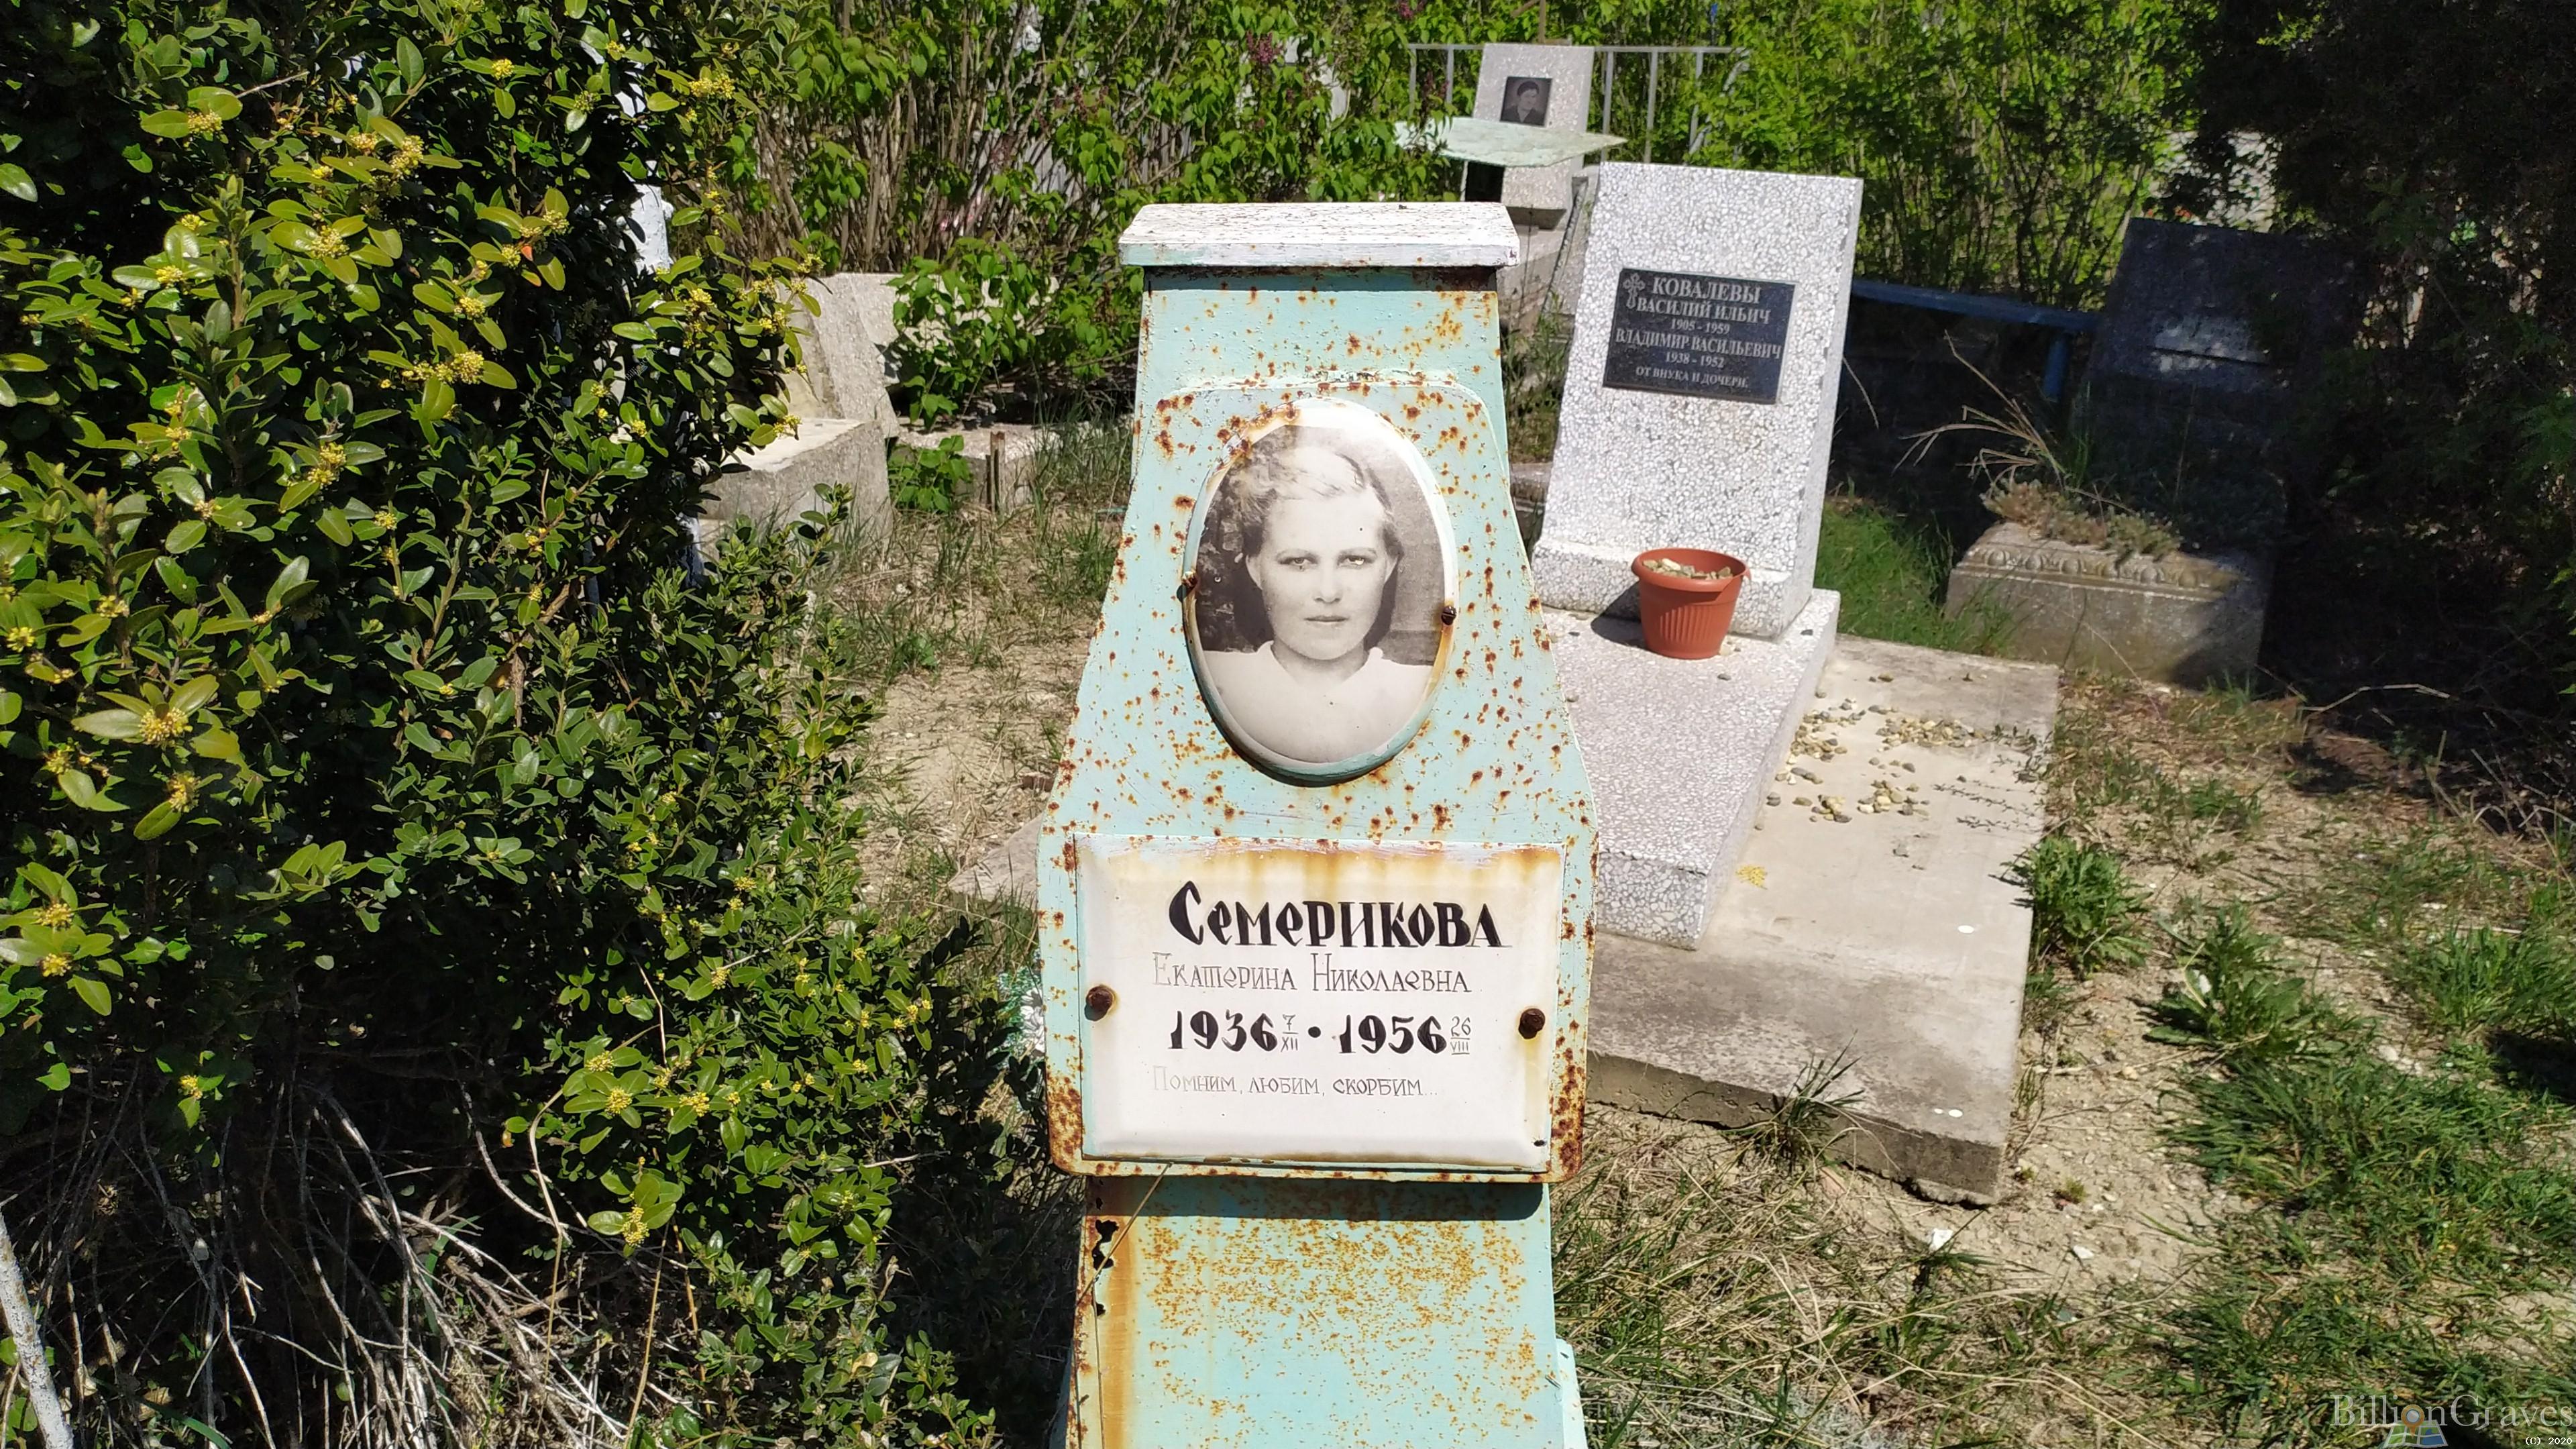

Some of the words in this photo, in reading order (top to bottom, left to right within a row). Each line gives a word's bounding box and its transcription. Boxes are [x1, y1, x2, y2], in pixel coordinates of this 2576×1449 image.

[1652, 277, 1762, 303] КОВАЛЕВЫ
[1637, 297, 1713, 318] ВАСИЛИЙ
[1714, 308, 1772, 325] ИЛЬИЧ
[1670, 319, 1695, 331] 1905
[1705, 322, 1730, 334] 1959
[1615, 328, 1690, 350] ВЛАДИМИР
[1691, 335, 1782, 360] ВАСИЛЬЕВИЧ
[1665, 351, 1690, 364] 1938
[1700, 356, 1725, 368] 1952
[1635, 366, 1650, 376] ОТ
[1653, 368, 1689, 382] ВНУКА
[1692, 372, 1700, 383] И
[1168, 1009, 1279, 1052] 1936
[1339, 1014, 1447, 1054] 1956
